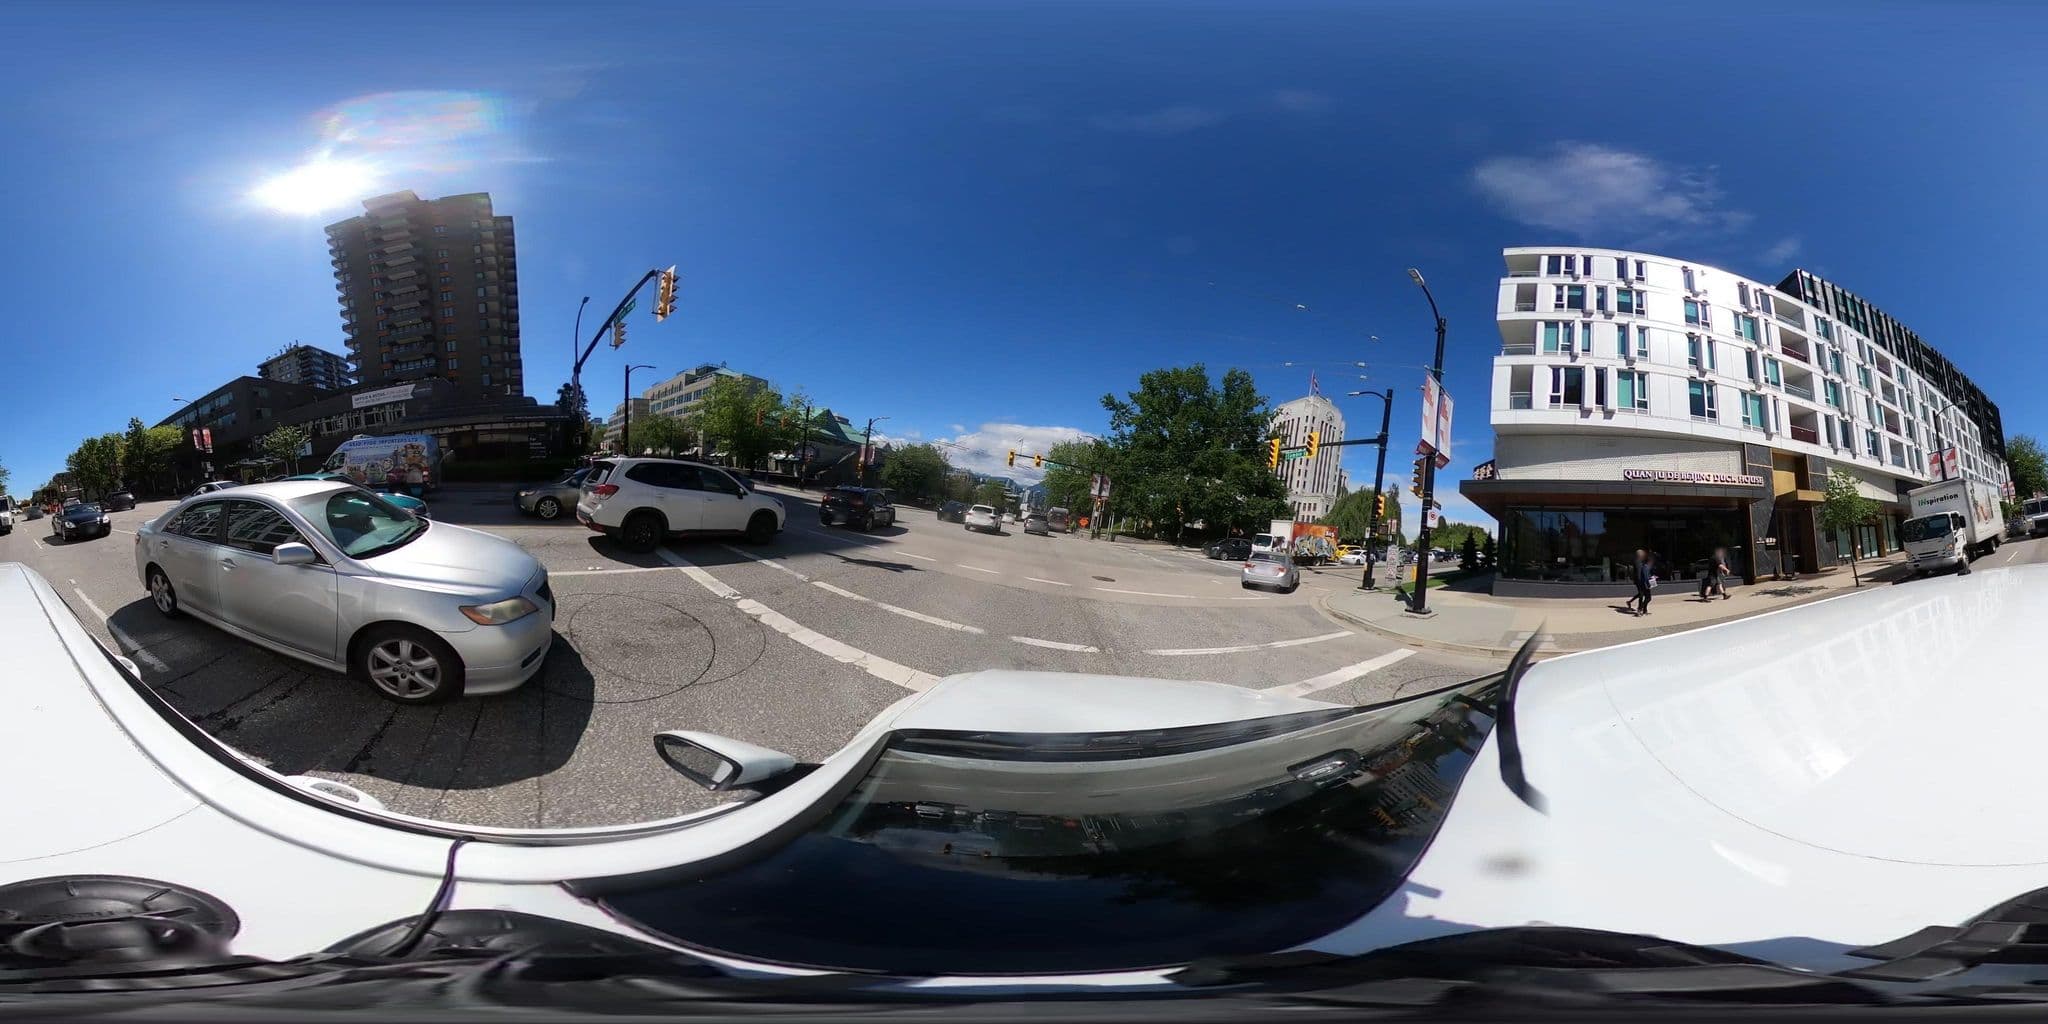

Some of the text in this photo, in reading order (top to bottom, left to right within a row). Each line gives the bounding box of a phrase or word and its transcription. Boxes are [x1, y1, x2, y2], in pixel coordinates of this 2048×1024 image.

[1624, 470, 1764, 485] QUAN JU DE BEIJING DUCK HOUSE
